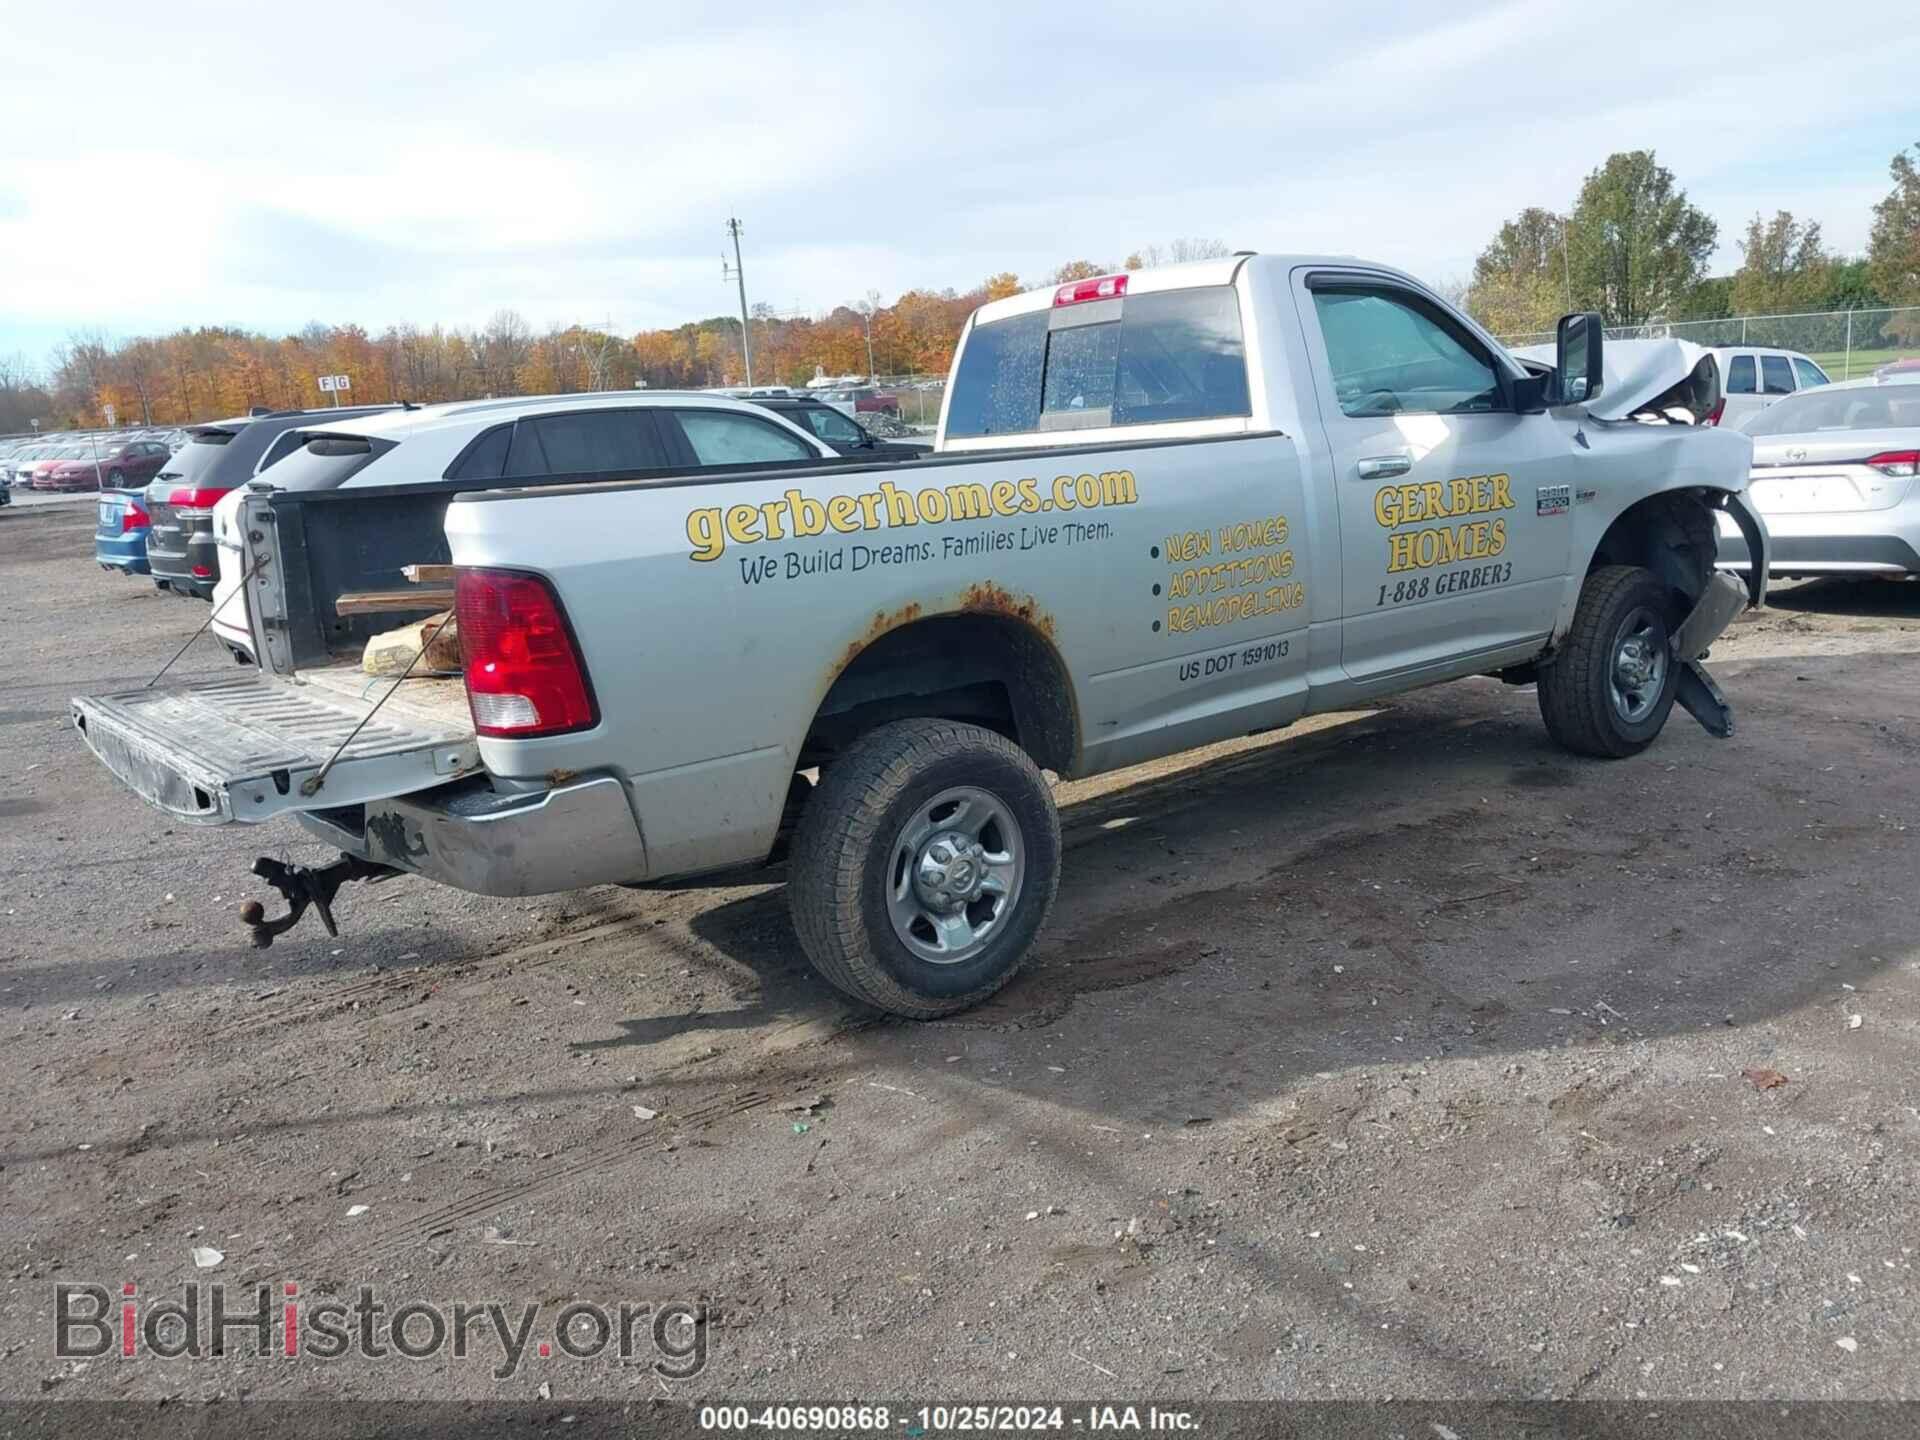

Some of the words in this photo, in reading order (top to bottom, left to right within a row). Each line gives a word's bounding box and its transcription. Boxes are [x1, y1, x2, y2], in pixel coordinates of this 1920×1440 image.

[686, 470, 1138, 561] gerberhomes.com
[1374, 473, 1515, 528] GERBER
[739, 556, 778, 584] We
[785, 547, 842, 580] Build
[852, 541, 935, 571] Dreams.
[942, 529, 1015, 560] Families
[1020, 525, 1058, 550] Live
[1063, 521, 1113, 546] Them.
[1165, 530, 1212, 563] NEW
[1219, 515, 1289, 554] HOMES
[1387, 518, 1506, 573] HOMES
[1168, 550, 1294, 599] ADDITIONS
[1376, 577, 1429, 606] 1-888
[1435, 562, 1513, 595] GERBER3
[1168, 582, 1304, 634] REMODELING
[1179, 663, 1200, 681] US
[1205, 653, 1237, 675] DOT
[1242, 640, 1289, 665] 1591013
